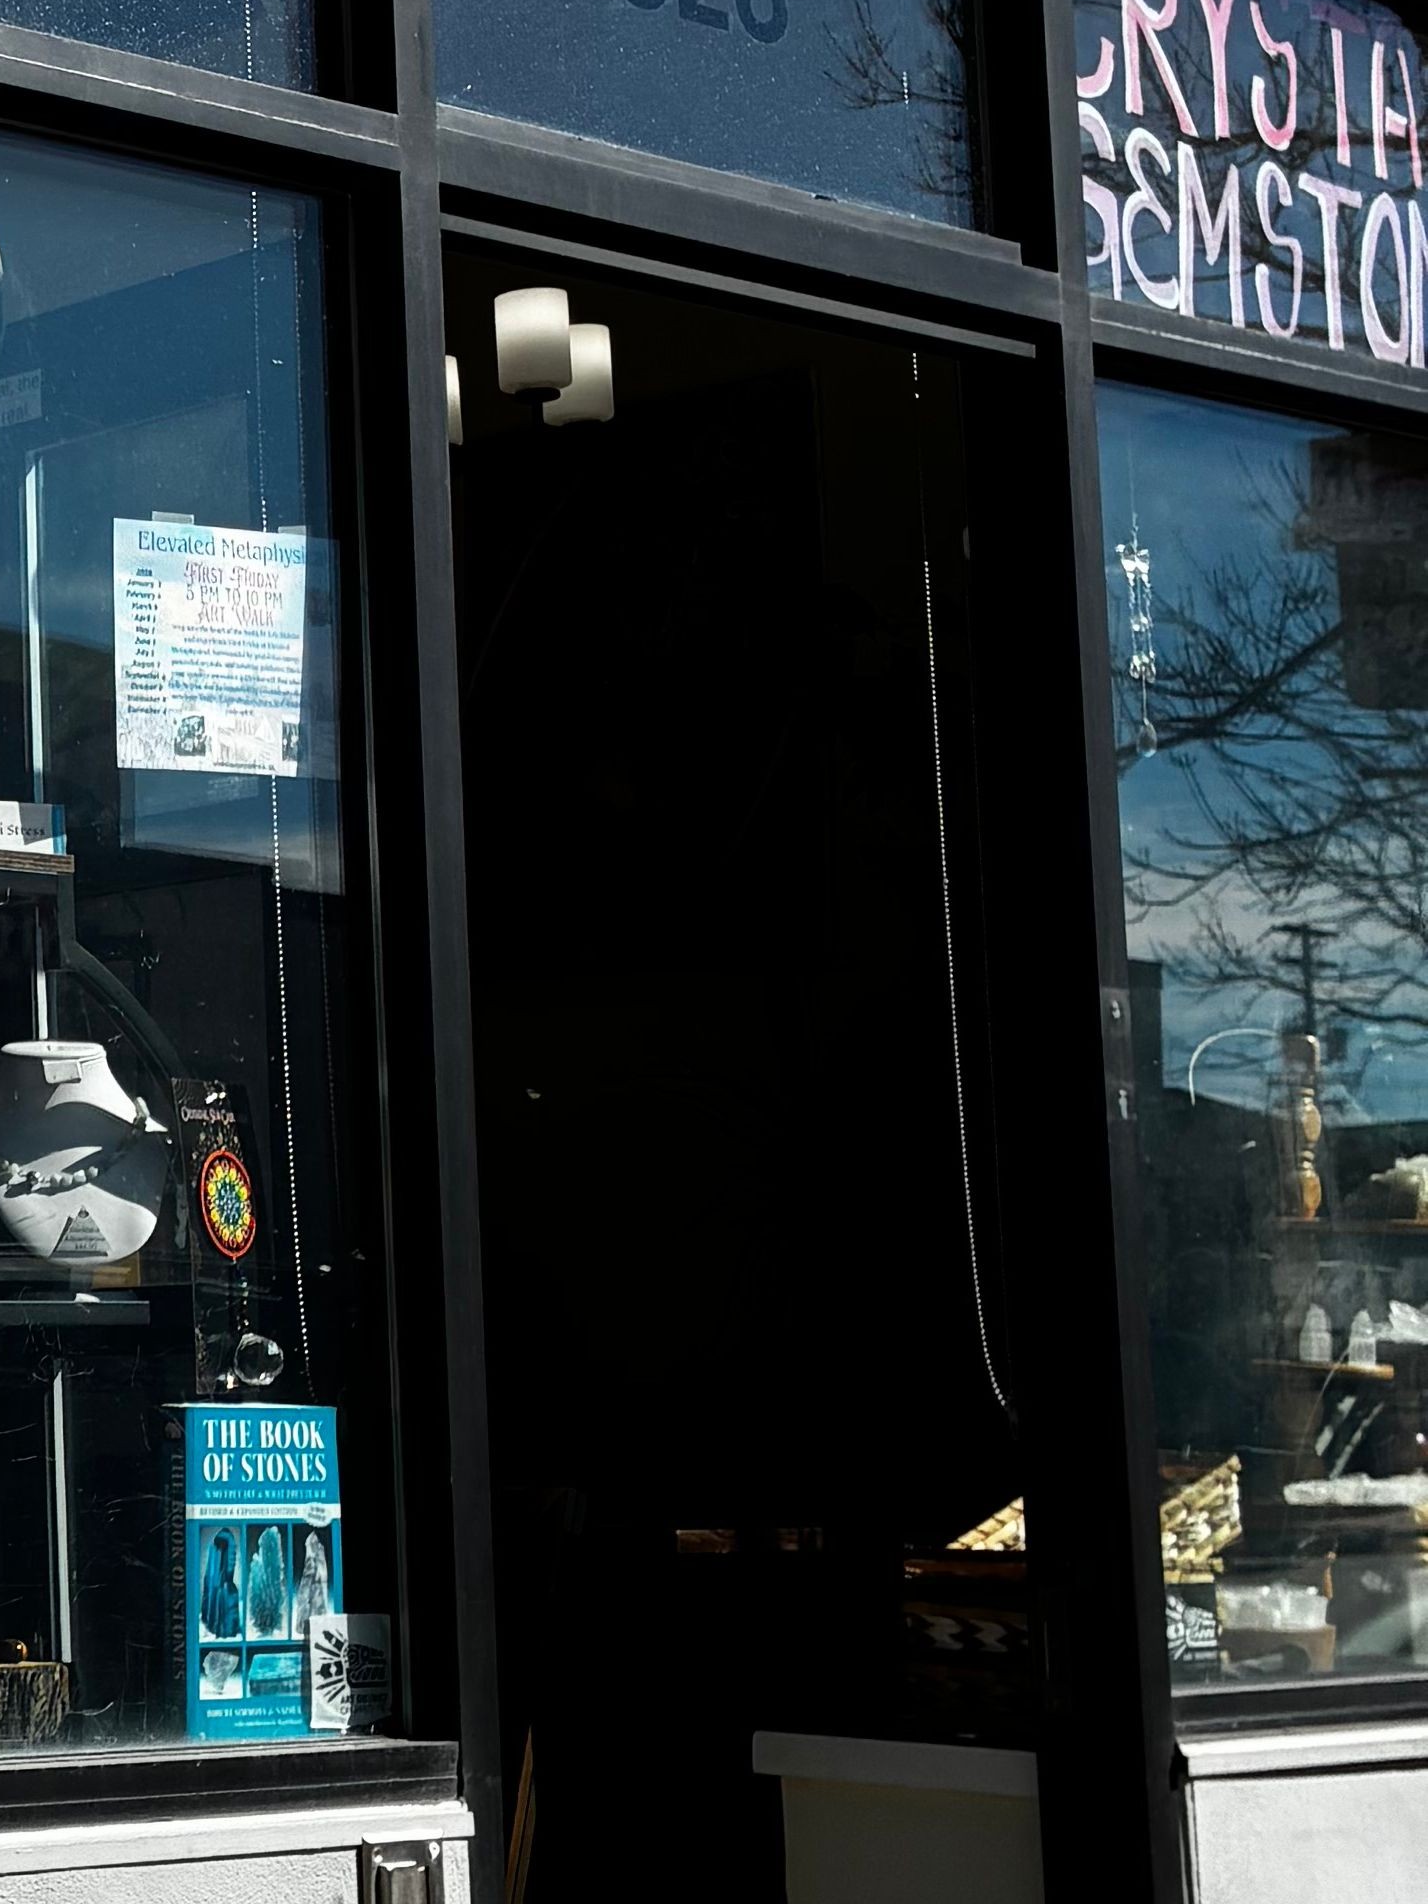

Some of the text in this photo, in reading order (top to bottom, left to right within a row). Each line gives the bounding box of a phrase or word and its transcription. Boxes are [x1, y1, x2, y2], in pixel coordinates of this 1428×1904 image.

[138, 530, 215, 556] Elevated
[200, 585, 219, 604] PM
[264, 591, 283, 609] PM
[7, 824, 45, 837] Stress
[203, 1419, 325, 1449] THE BOOK
[203, 1453, 327, 1482] OF STONES
